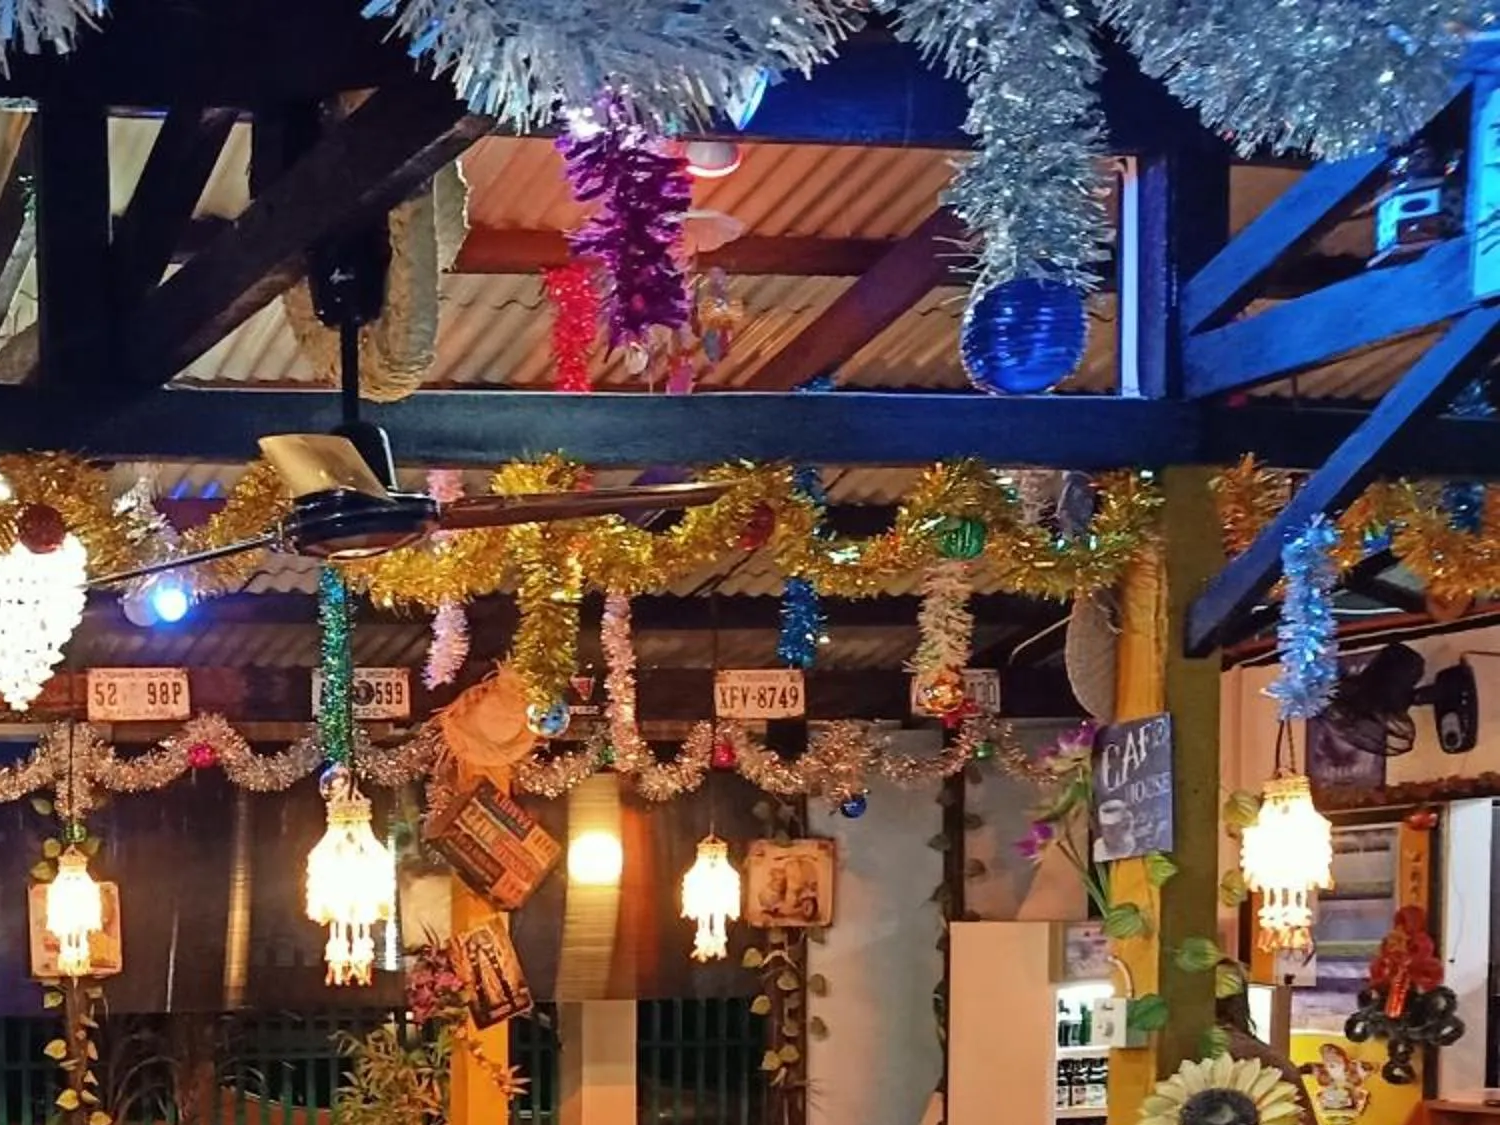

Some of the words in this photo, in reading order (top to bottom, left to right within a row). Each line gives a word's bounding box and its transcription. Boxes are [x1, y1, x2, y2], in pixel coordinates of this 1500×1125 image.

[95, 682, 118, 706] 52
[147, 682, 182, 705] 98P
[719, 686, 799, 708] XFV-8749
